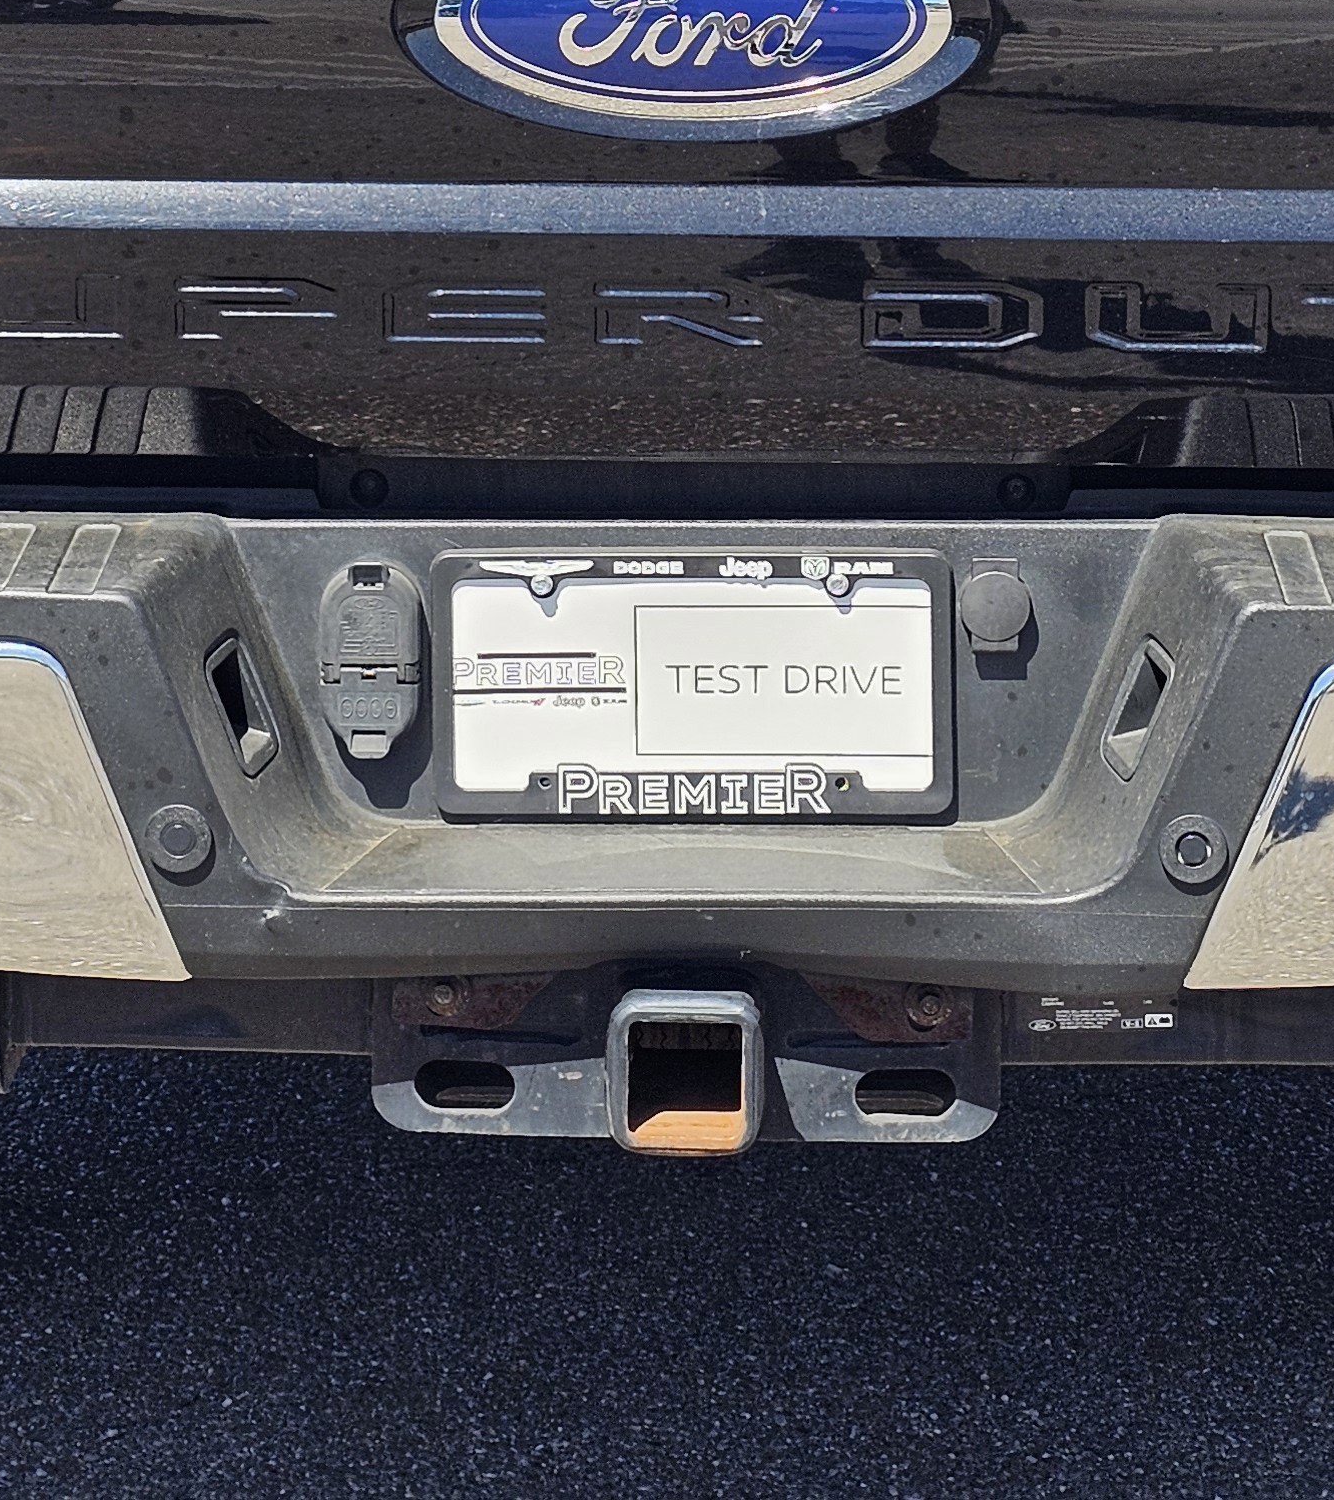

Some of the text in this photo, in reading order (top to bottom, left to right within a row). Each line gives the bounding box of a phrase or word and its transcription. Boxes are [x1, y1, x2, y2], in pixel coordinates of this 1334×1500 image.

[613, 556, 895, 581] DODGE Jeep RAM
[453, 655, 626, 686] PREMIER
[665, 664, 903, 695] TEST DRIVE
[557, 761, 833, 816] PREMIER
